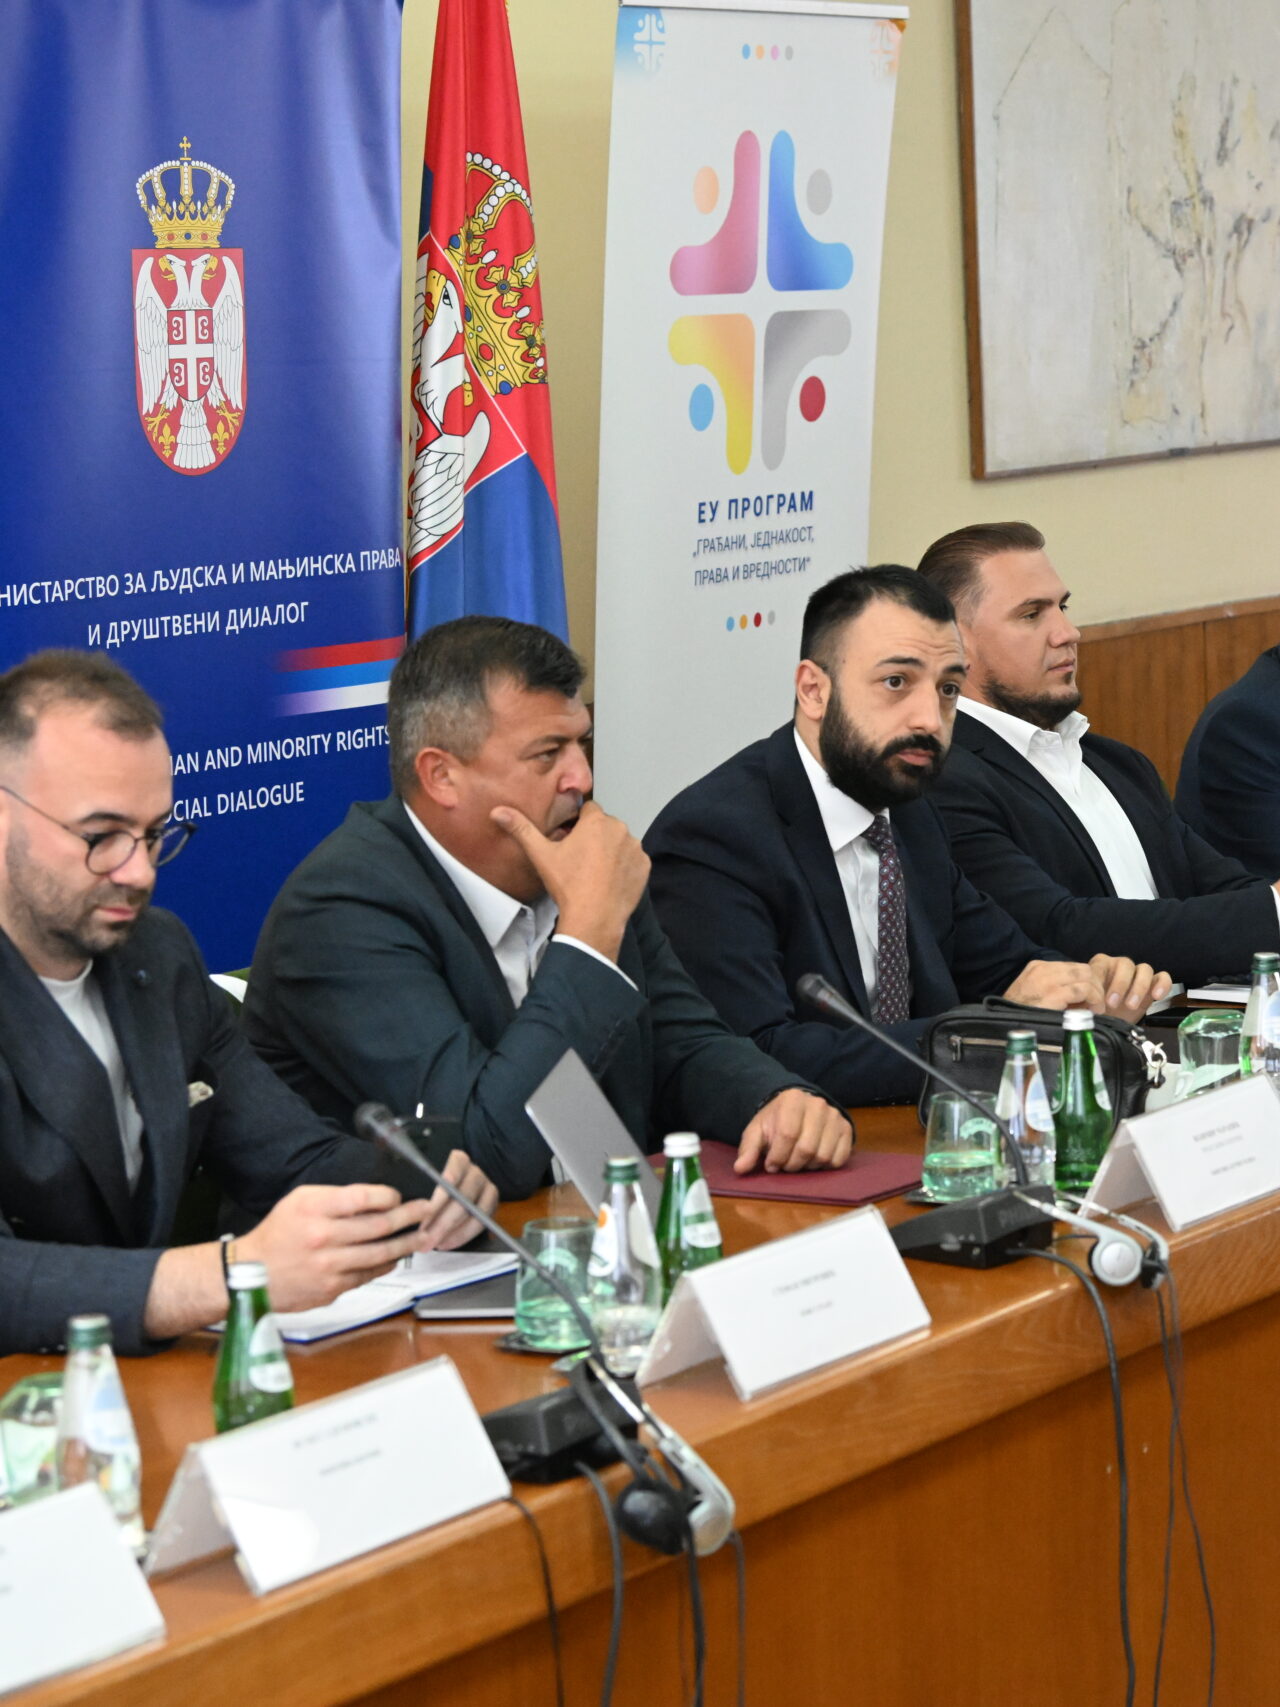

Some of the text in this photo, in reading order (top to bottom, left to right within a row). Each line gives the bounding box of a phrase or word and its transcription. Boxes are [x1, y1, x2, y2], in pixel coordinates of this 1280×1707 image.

[697, 490, 814, 524] ЕУ ПРОГРАМ
[124, 572, 147, 594] ЗА
[151, 565, 227, 594] ЉУДСКА
[232, 563, 245, 584] И
[250, 553, 356, 582] МАЊИНСКА
[360, 547, 401, 572] ПРАВА
[694, 567, 729, 586] ПРАВА
[732, 565, 740, 581] И
[88, 602, 309, 649] И ДРУШТВЕНИ ДИЈАЛОГ
[169, 752, 199, 776] AN
[204, 746, 242, 771] AND
[247, 733, 332, 765] MINORITY
[217, 781, 305, 814] DIALOGUE
